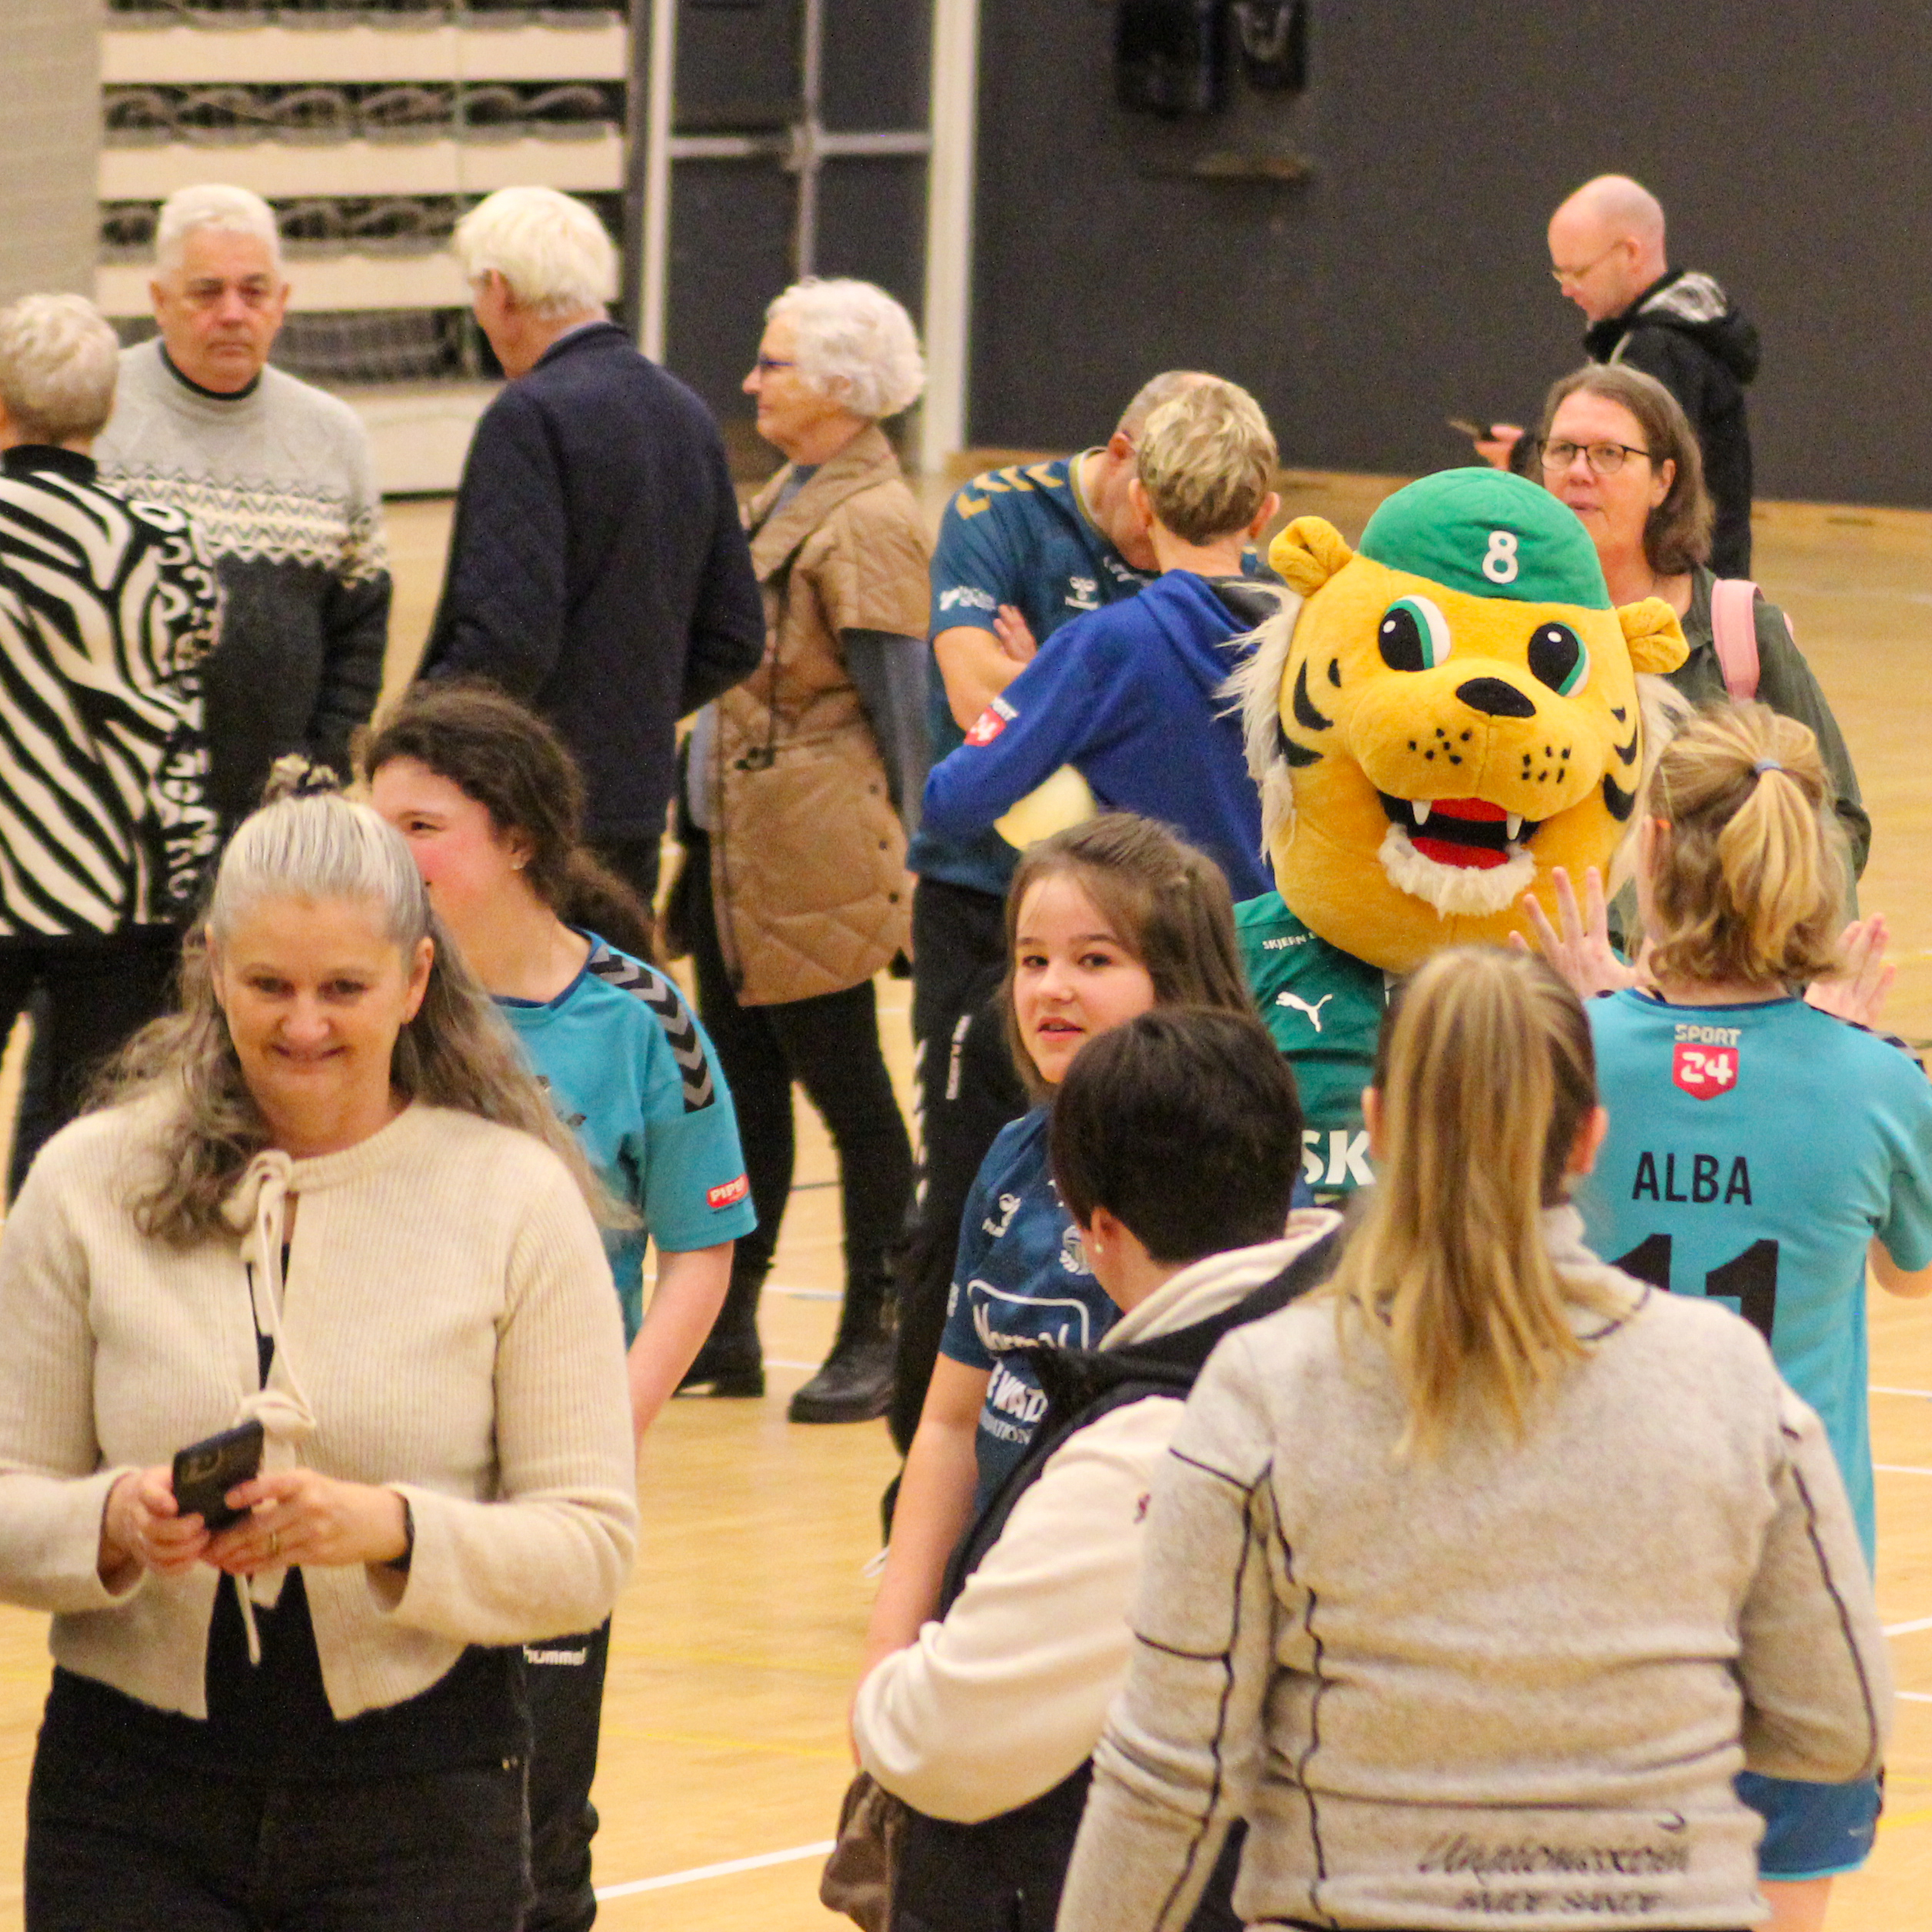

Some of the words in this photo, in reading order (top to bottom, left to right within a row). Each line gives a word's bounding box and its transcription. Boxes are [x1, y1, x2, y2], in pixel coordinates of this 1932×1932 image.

[1481, 530, 1519, 585] 8
[1674, 1024, 1742, 1047] SPORT
[1681, 1051, 1734, 1086] 24
[1631, 1151, 1753, 1206] ALBA
